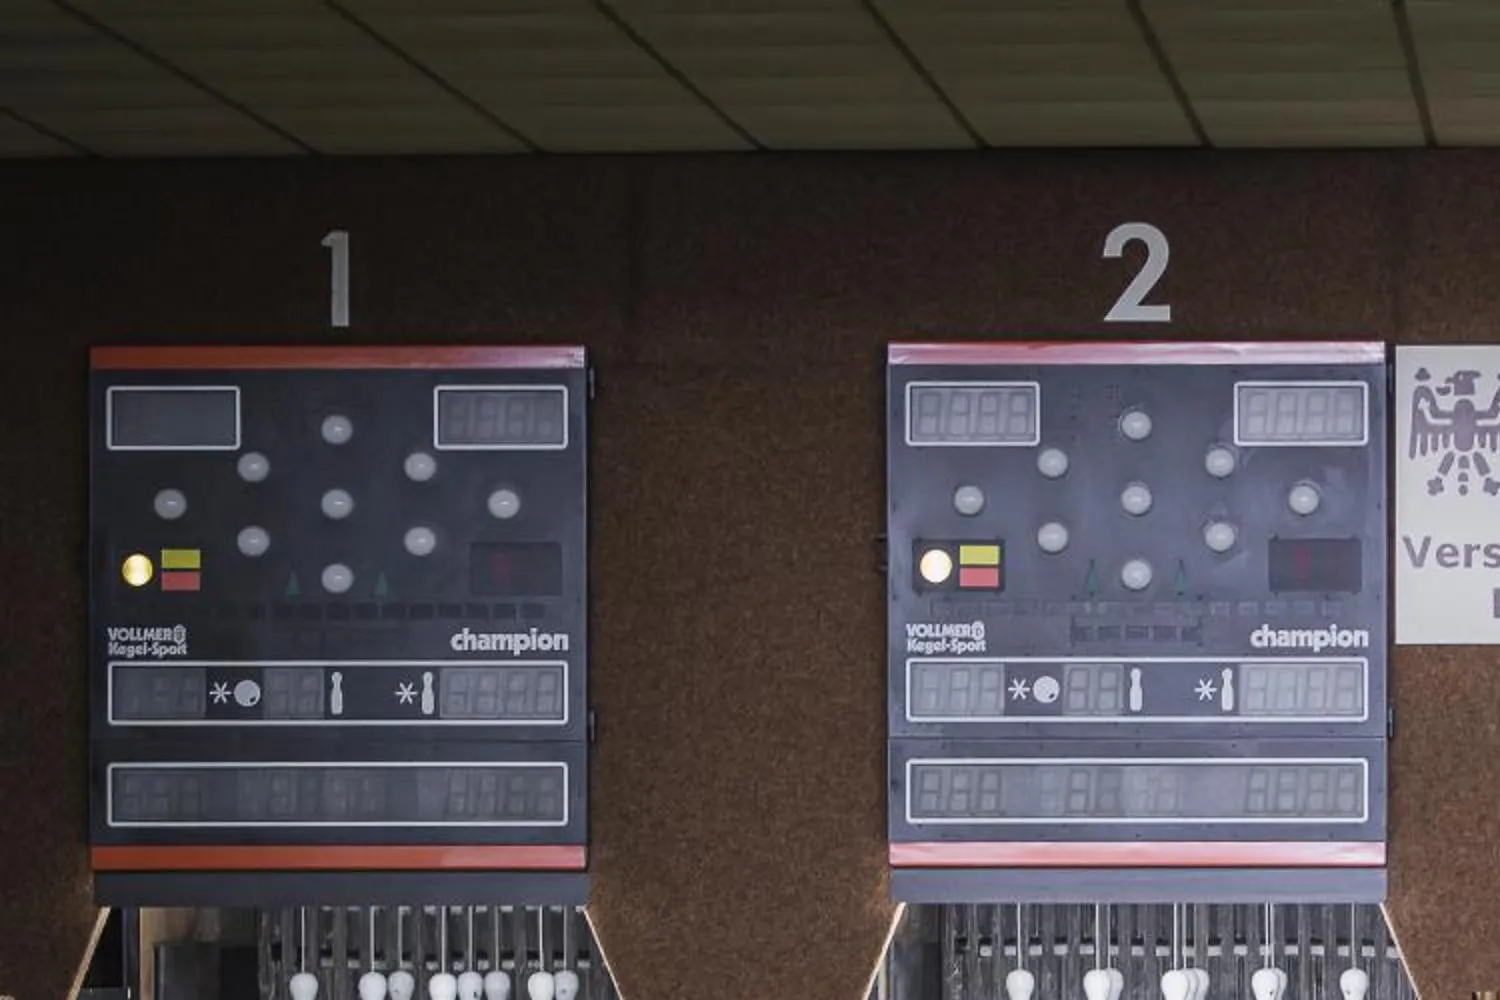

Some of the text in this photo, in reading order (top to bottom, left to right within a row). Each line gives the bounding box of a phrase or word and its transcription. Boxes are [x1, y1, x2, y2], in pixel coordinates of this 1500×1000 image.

[321, 231, 350, 327] 1
[1102, 222, 1171, 322] 2
[107, 627, 173, 641] VOLLMER
[450, 627, 569, 656] champion
[906, 623, 971, 637] VOLLMER
[1250, 623, 1370, 652] champion
